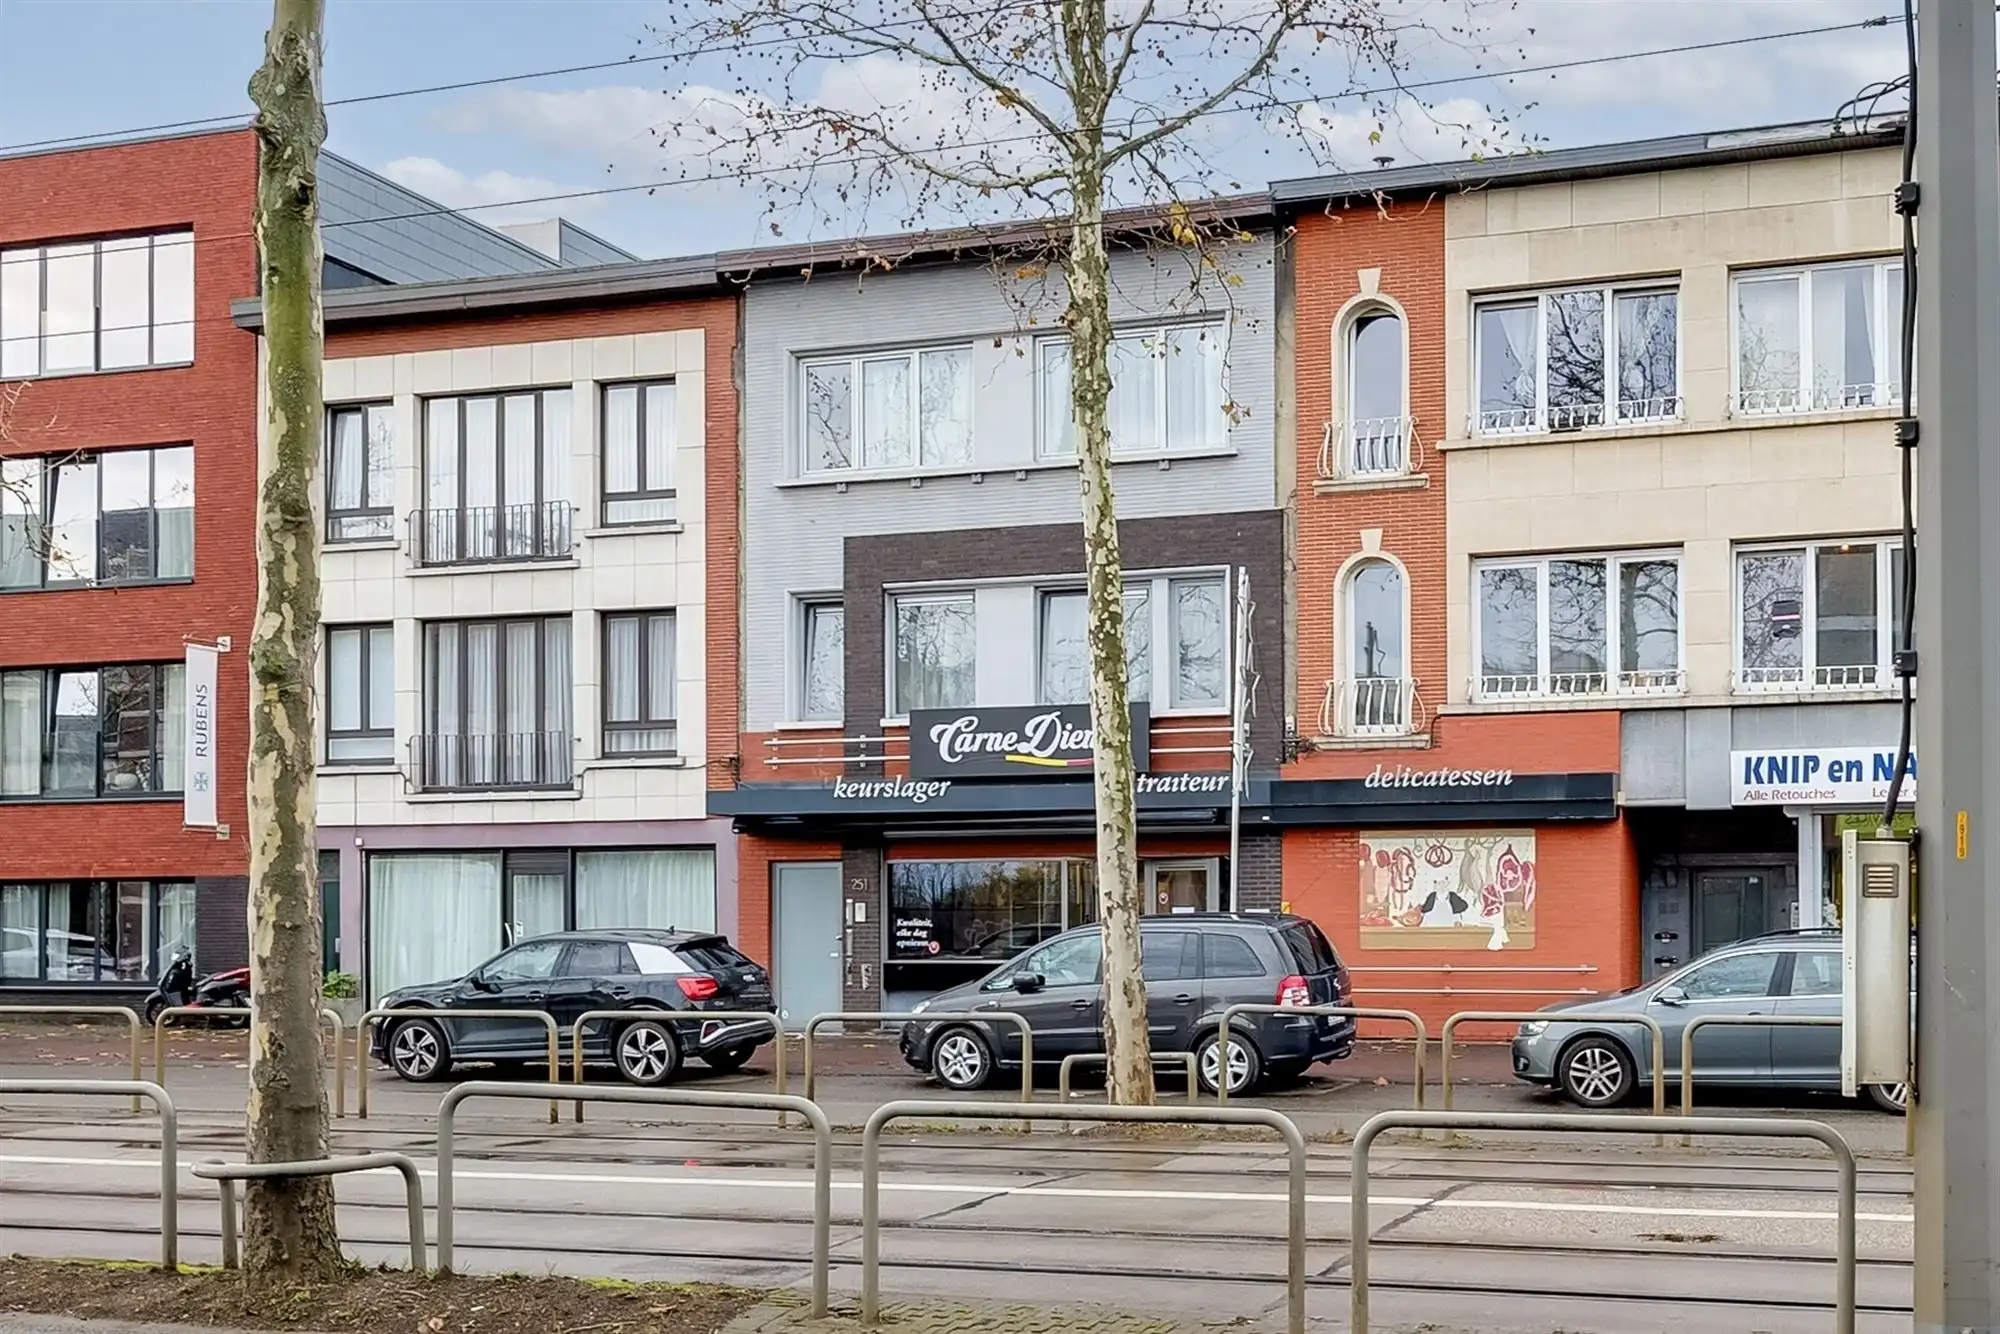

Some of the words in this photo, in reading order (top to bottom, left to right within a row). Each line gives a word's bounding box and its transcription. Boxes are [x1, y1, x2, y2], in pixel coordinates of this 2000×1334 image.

[195, 684, 208, 758] RUBENS
[929, 715, 1018, 763] Carne
[1136, 773, 1229, 793] traiteur
[1364, 764, 1513, 788] delicatessen
[1743, 755, 1820, 785] KNIP
[1828, 759, 1863, 783] en
[833, 774, 951, 803] keurslager
[1743, 790, 1768, 800] Alle
[1772, 788, 1836, 800] Retouches
[851, 878, 868, 891] 251
